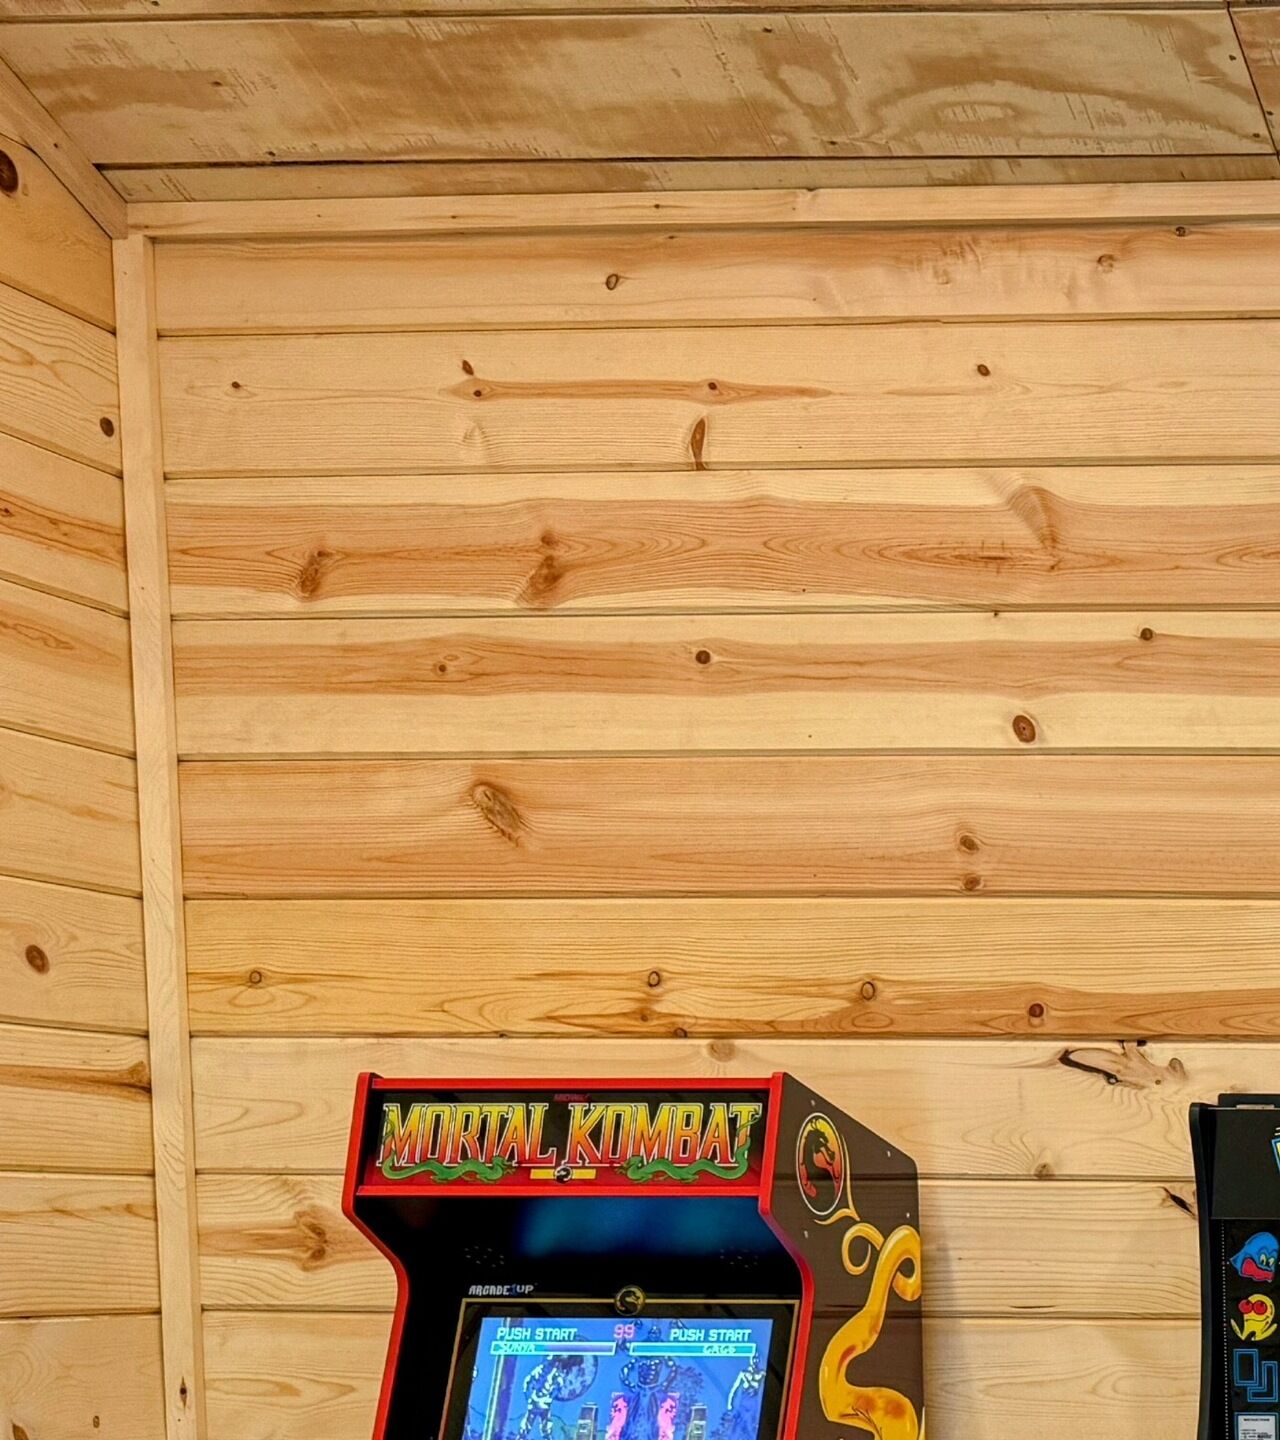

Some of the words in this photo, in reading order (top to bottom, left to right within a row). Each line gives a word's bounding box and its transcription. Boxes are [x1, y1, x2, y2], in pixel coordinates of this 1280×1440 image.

[376, 1102, 558, 1168] MORTAL
[561, 1102, 763, 1168] KOMBAT
[496, 1327, 532, 1341] PUSH
[535, 1327, 578, 1341] START
[613, 1324, 635, 1339] 99
[670, 1328, 705, 1342] PUSH
[708, 1328, 752, 1342] START
